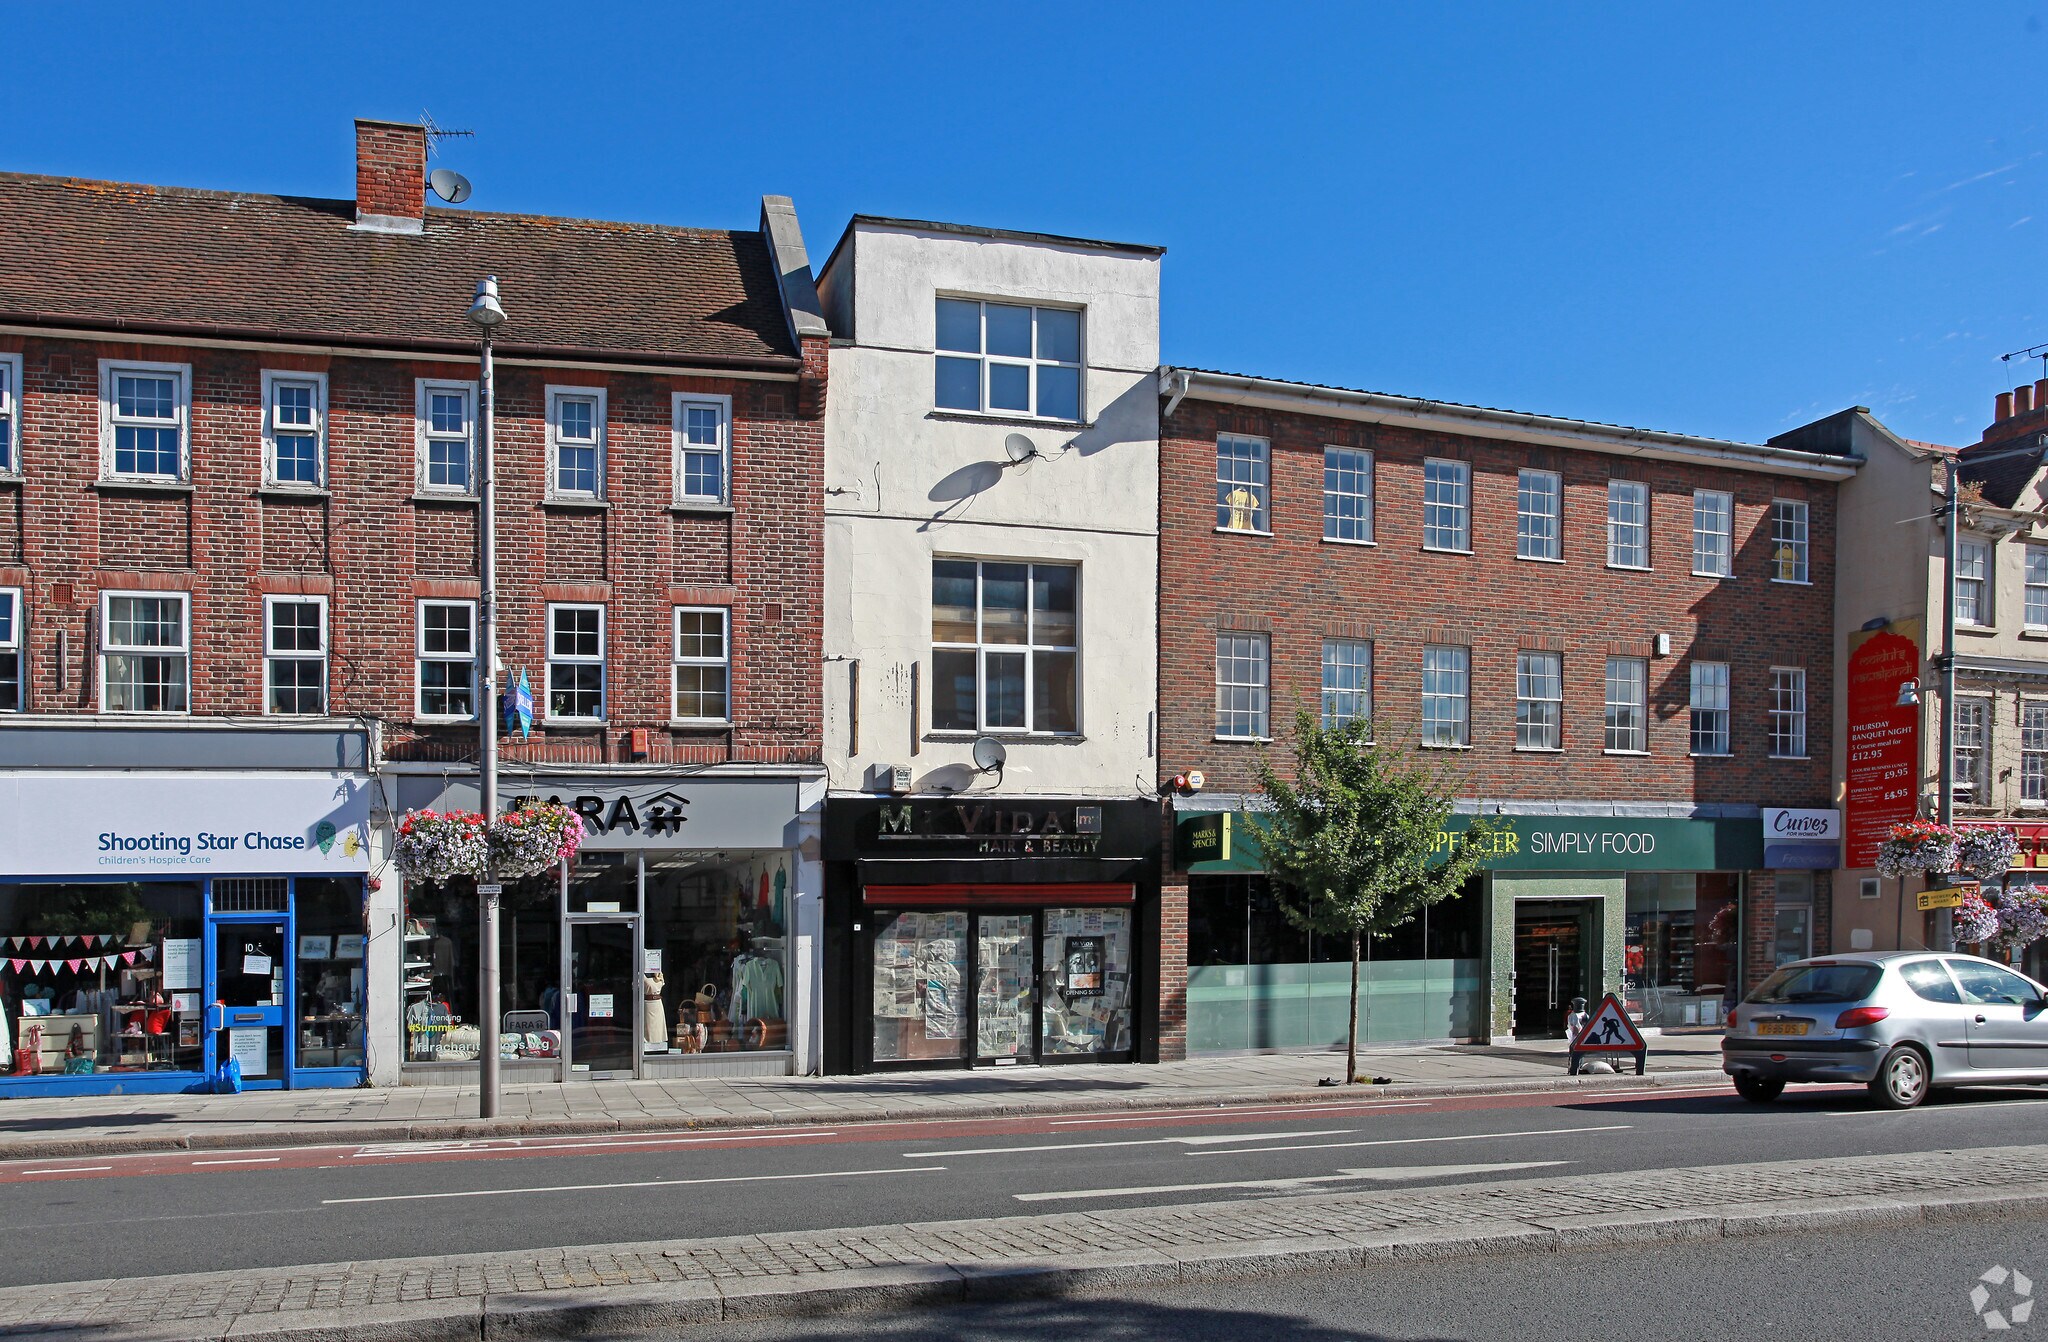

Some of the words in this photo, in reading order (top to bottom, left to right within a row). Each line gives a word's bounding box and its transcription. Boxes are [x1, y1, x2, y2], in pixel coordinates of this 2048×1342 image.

[1852, 721, 1890, 732] THURSDAY
[1852, 730, 1886, 741] BANQUET
[1888, 726, 1912, 736] NIGHT
[1856, 742, 1876, 750] Course
[1852, 750, 1882, 761] £12.95
[1884, 768, 1908, 780] £9.95
[1774, 810, 1828, 834] Curves
[1193, 830, 1212, 840] MARKS
[1212, 828, 1216, 837] &
[98, 832, 191, 856] Shooting
[197, 832, 238, 850] Star
[244, 832, 305, 850] Chase
[978, 840, 1016, 854] HAIR
[1024, 840, 1034, 853] &
[1043, 840, 1099, 854] BEAUTY
[1192, 838, 1216, 849] SPENCER
[1530, 832, 1598, 854] SIMPLY
[1602, 832, 1655, 854] FOOD
[98, 856, 146, 865] Children's
[149, 856, 187, 866] Hospice
[189, 856, 211, 864] Care
[245, 944, 253, 952] 10
[409, 1023, 459, 1032] #Summer
[509, 1020, 534, 1030] FARA
[417, 1040, 550, 1052] faracharitops.org
